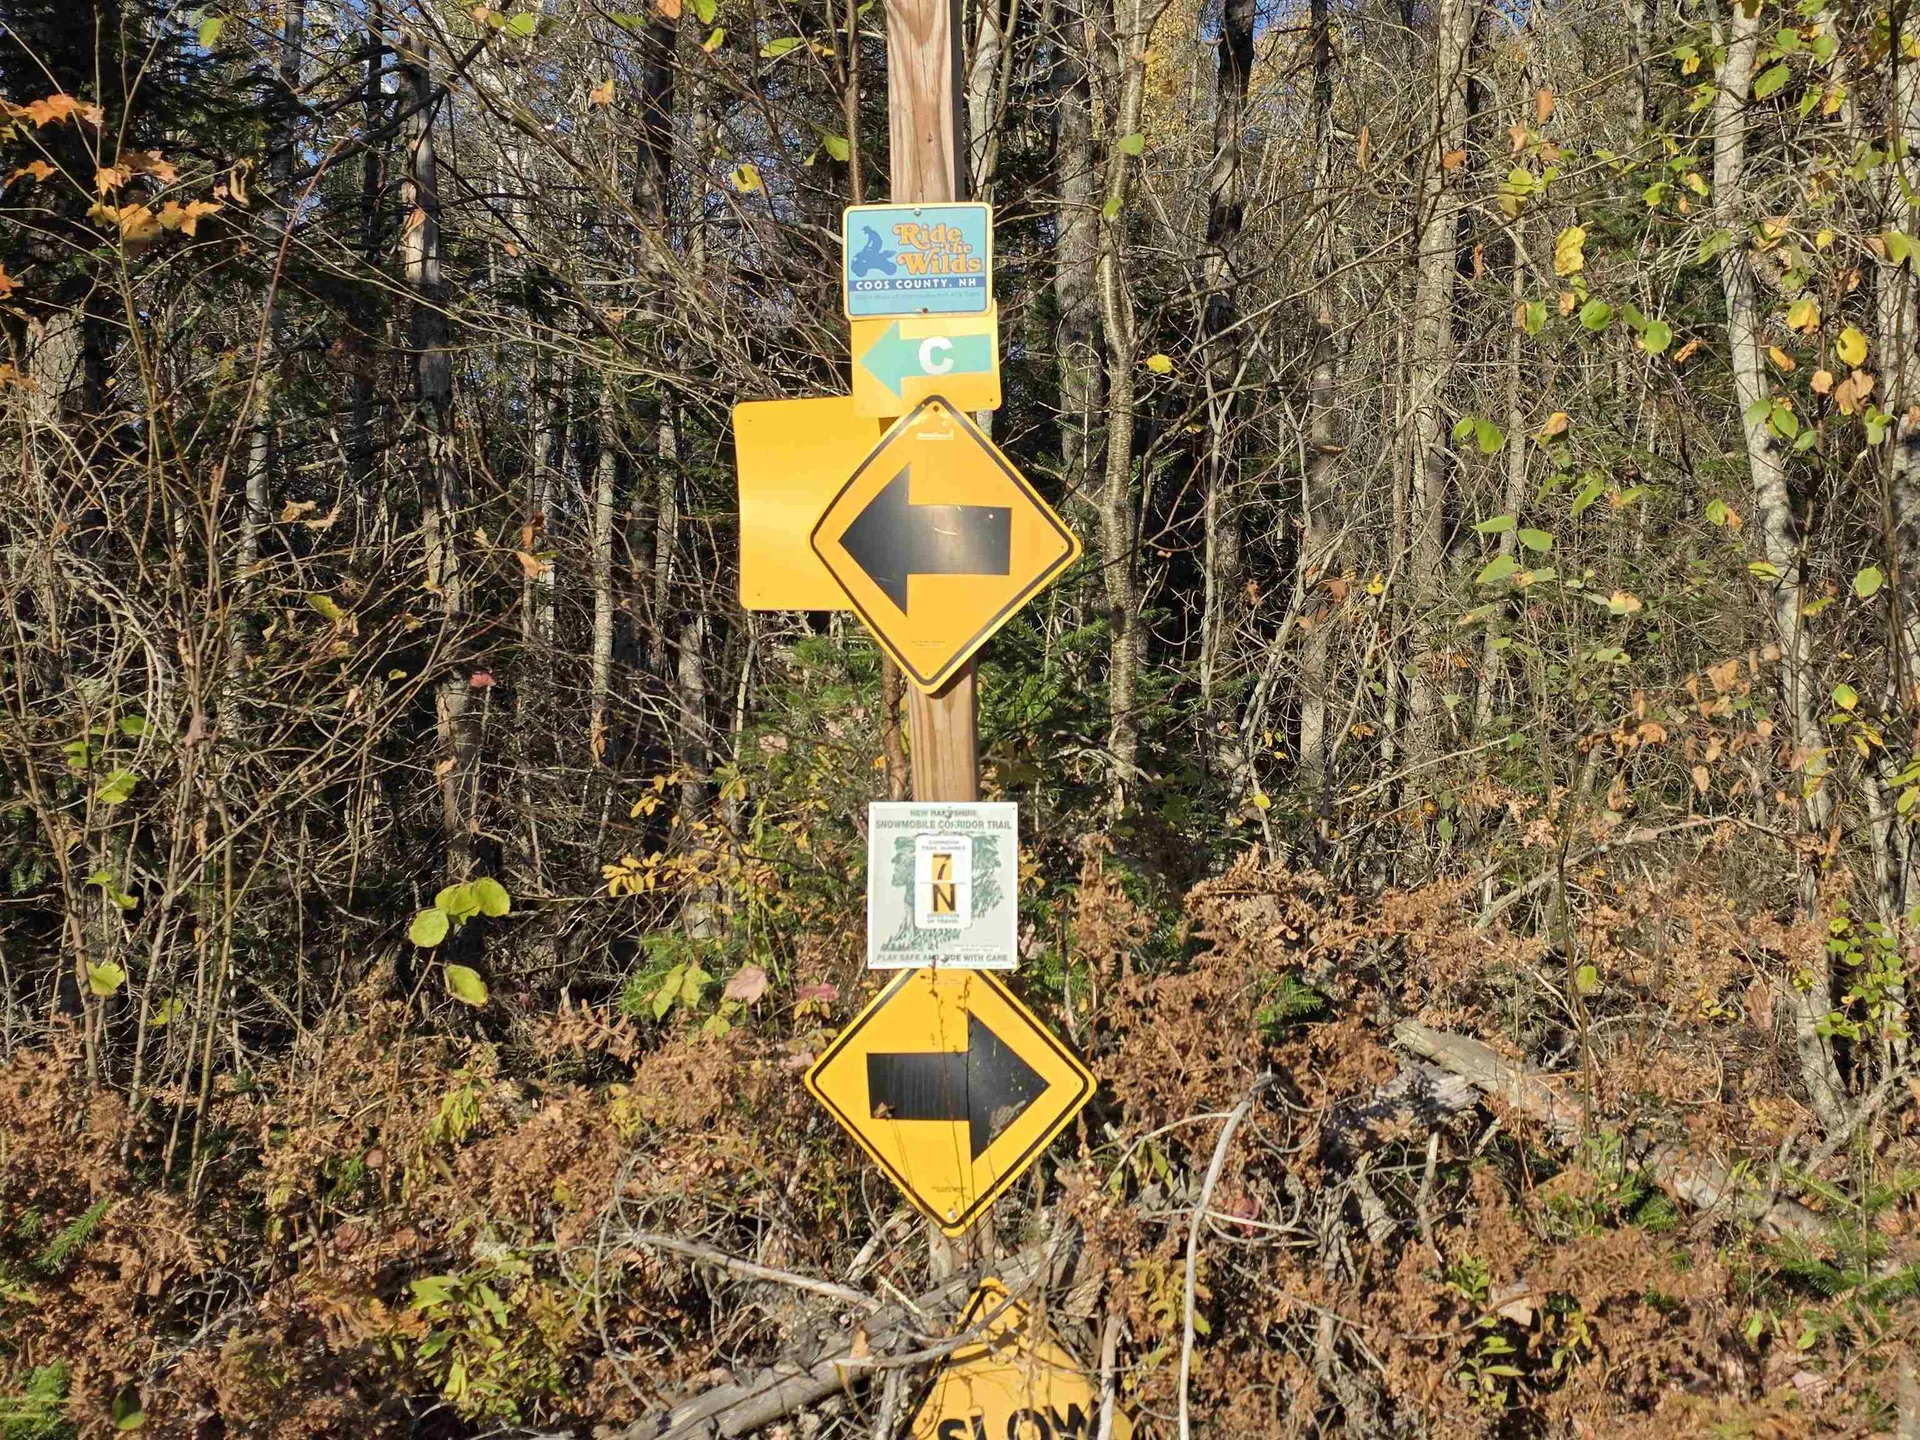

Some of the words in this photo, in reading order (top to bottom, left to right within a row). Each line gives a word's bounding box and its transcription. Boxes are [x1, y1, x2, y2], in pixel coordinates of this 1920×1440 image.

[892, 223, 962, 250] Ride
[943, 241, 972, 254] the
[896, 248, 982, 275] Wilds
[856, 281, 889, 290] COOS
[959, 278, 976, 287] NH
[918, 336, 954, 375] C
[875, 820, 935, 829] SNOWMOBILE
[987, 820, 1012, 829] TRAIL
[932, 853, 952, 880] 7
[933, 883, 956, 912] N
